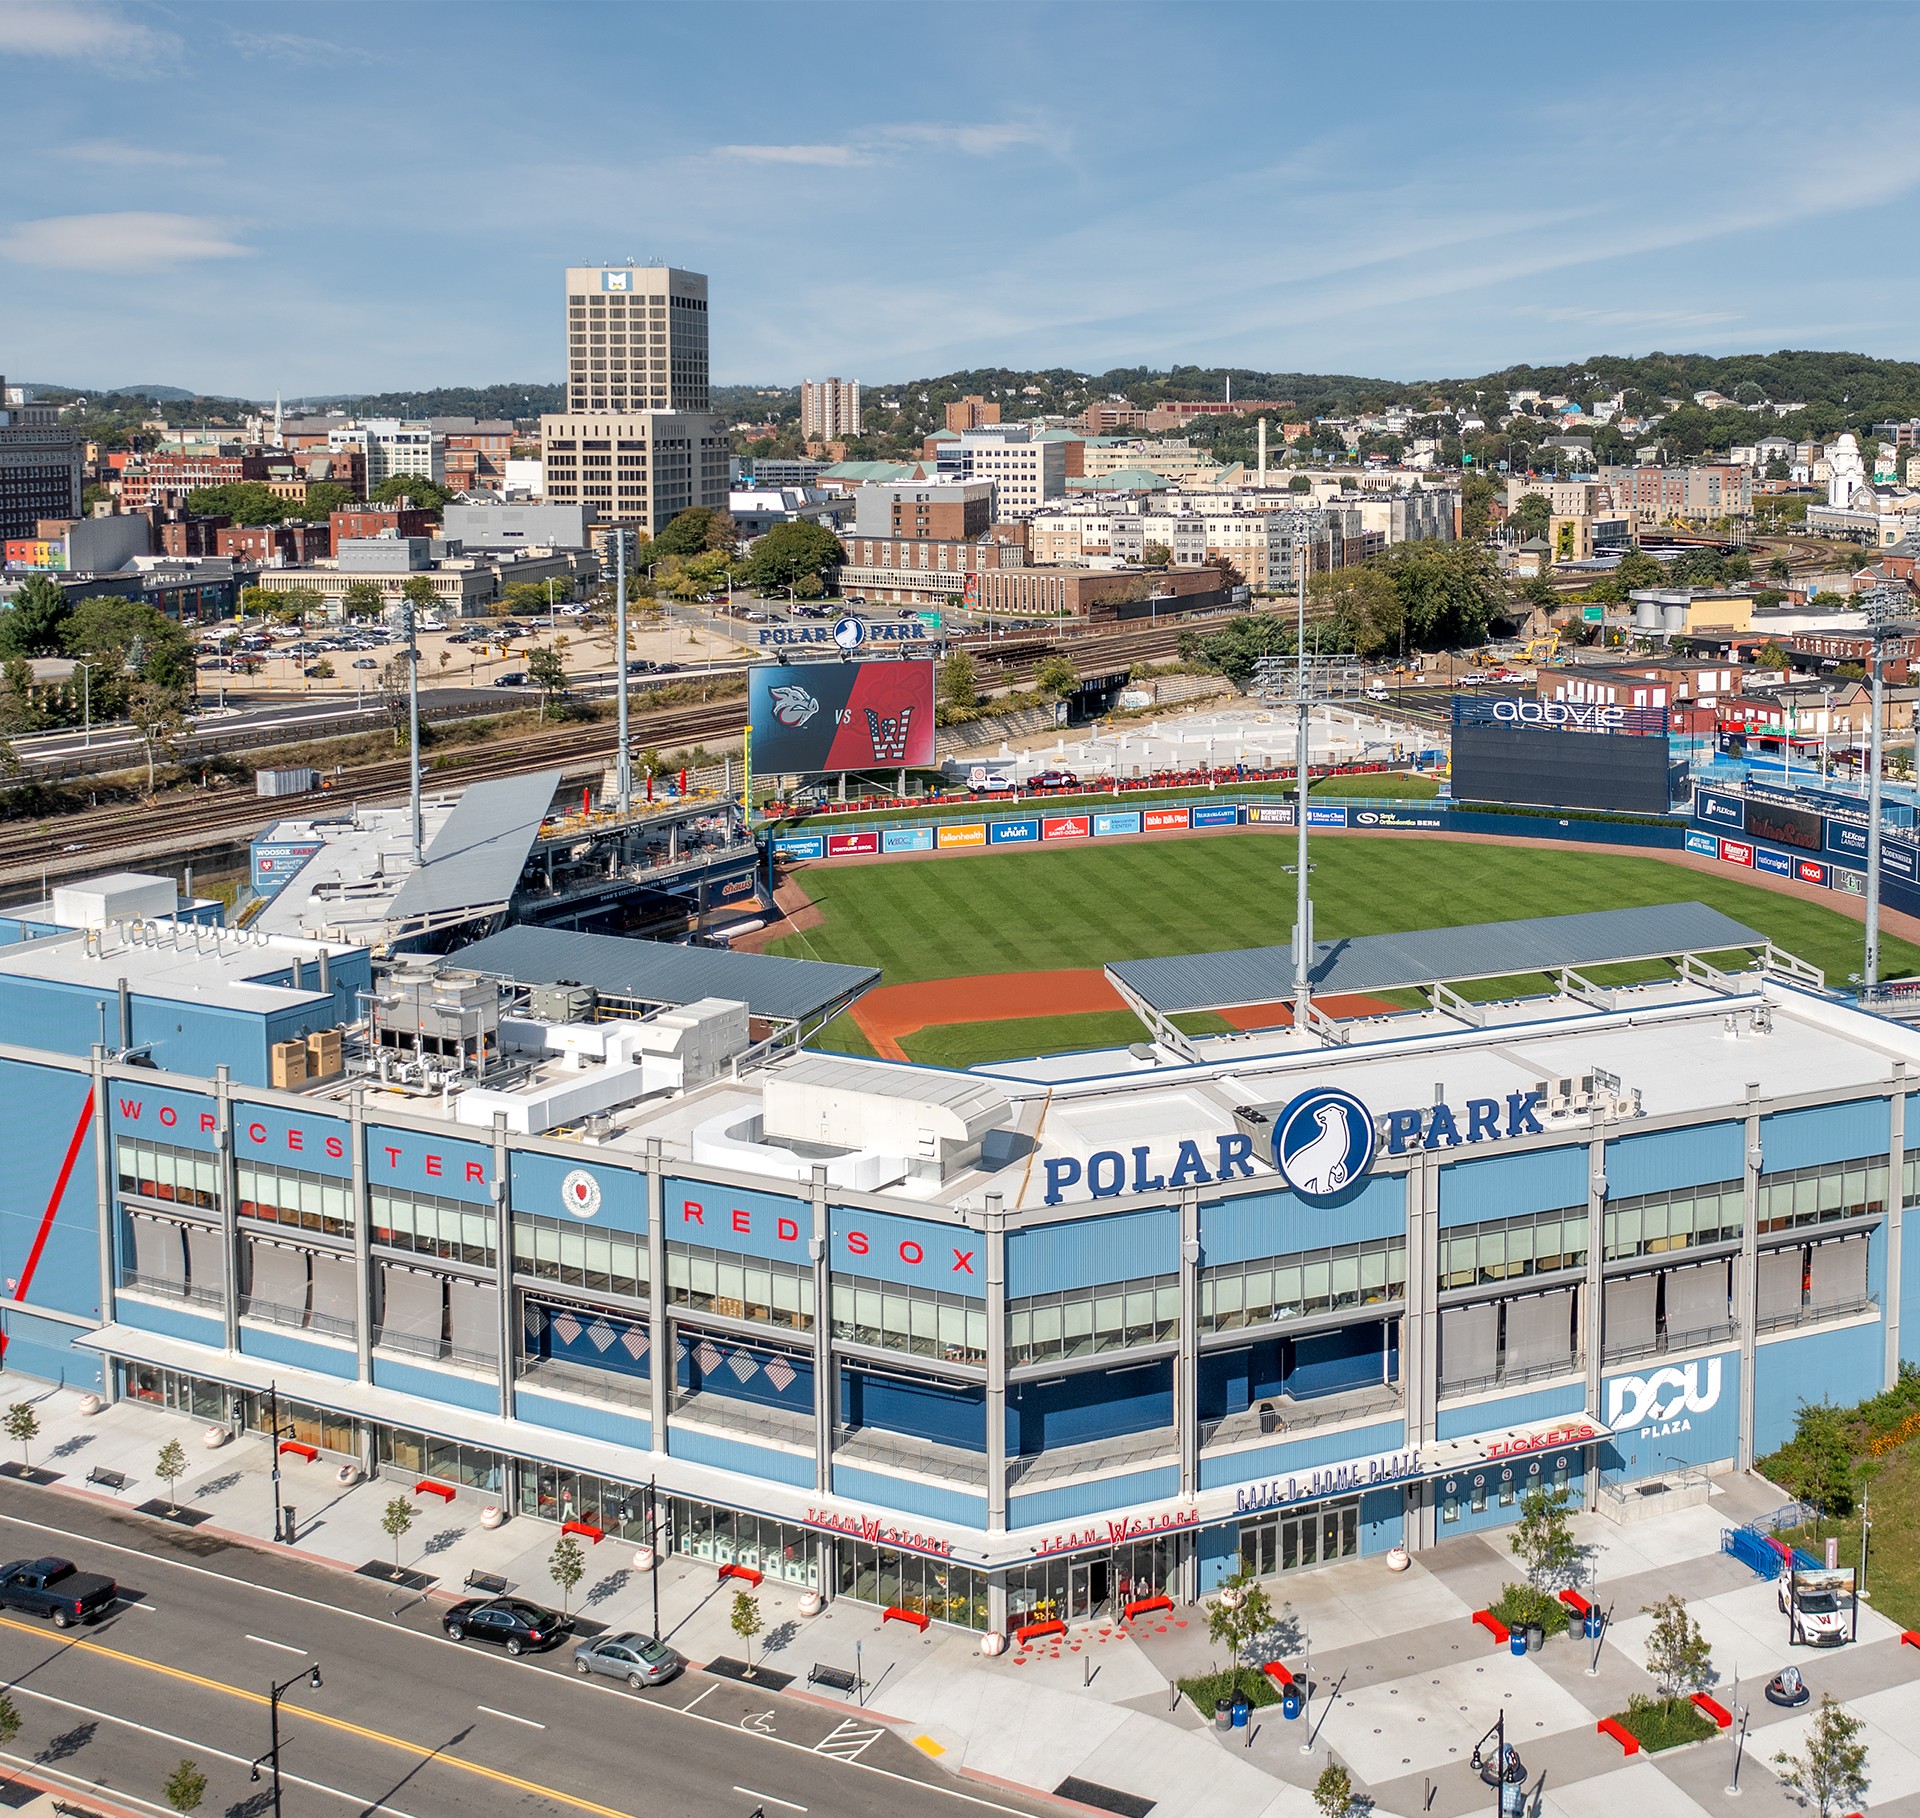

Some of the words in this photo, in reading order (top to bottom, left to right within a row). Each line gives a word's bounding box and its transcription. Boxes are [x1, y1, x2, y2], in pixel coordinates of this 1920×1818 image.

[759, 627, 828, 645] POLAR
[870, 623, 927, 640] PARK
[835, 709, 852, 725] VS
[1493, 697, 1624, 727] abbvie
[1174, 814, 1188, 824] Pies
[1417, 819, 1440, 827] BERM
[941, 831, 984, 842] fallonhealth
[1048, 829, 1085, 837] SAINT-GOBAIN
[786, 842, 819, 850] Assumption
[1724, 843, 1749, 857] Manny's
[1841, 838, 1866, 849] LANDING
[660, 875, 680, 885] TERRACE
[1801, 866, 1820, 879] Hood
[1044, 1133, 1254, 1206] POLAR
[1388, 1092, 1544, 1155] PARK
[684, 1200, 799, 1242] RED
[847, 1231, 974, 1275] SOX
[1608, 1357, 1722, 1432] DCU
[1641, 1418, 1691, 1439] PLAZA
[1487, 1423, 1595, 1457] TICKETS
[1236, 1480, 1280, 1512] GATE
[1287, 1476, 1298, 1502] D
[1311, 1463, 1361, 1497] HOME
[1368, 1450, 1422, 1485] PLATE
[807, 1507, 856, 1532] TEAM
[888, 1526, 950, 1555] STORE
[1040, 1529, 1097, 1554] TEAM
[1133, 1508, 1200, 1533] STORE
